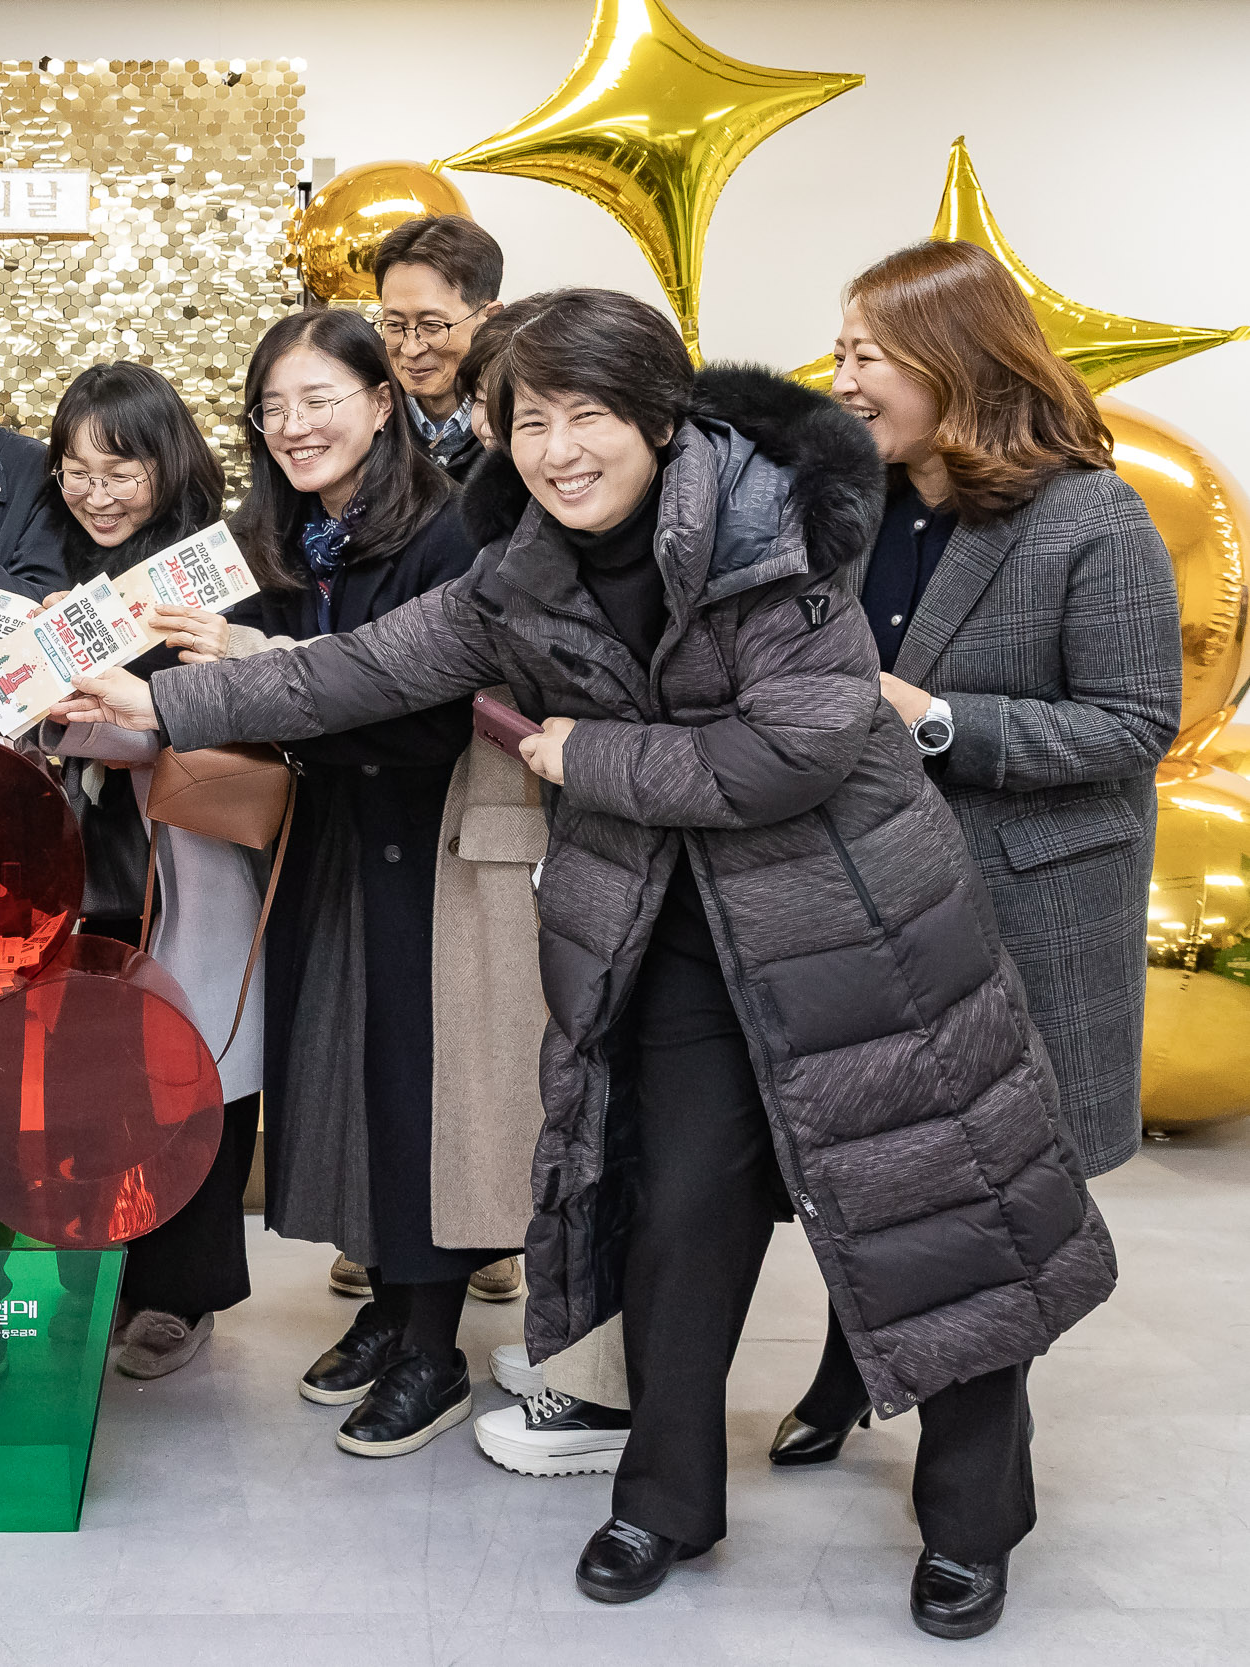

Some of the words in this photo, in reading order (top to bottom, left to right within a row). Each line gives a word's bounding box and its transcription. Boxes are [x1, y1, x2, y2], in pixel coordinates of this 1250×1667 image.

[26, 180, 62, 217] 날
[178, 546, 219, 606] 따뜻한
[195, 542, 211, 563] 2026
[50, 613, 93, 672] 겨울나기
[63, 602, 110, 664] 따뜻한
[79, 597, 98, 620] 2026
[93, 619, 120, 654] 희망온돌
